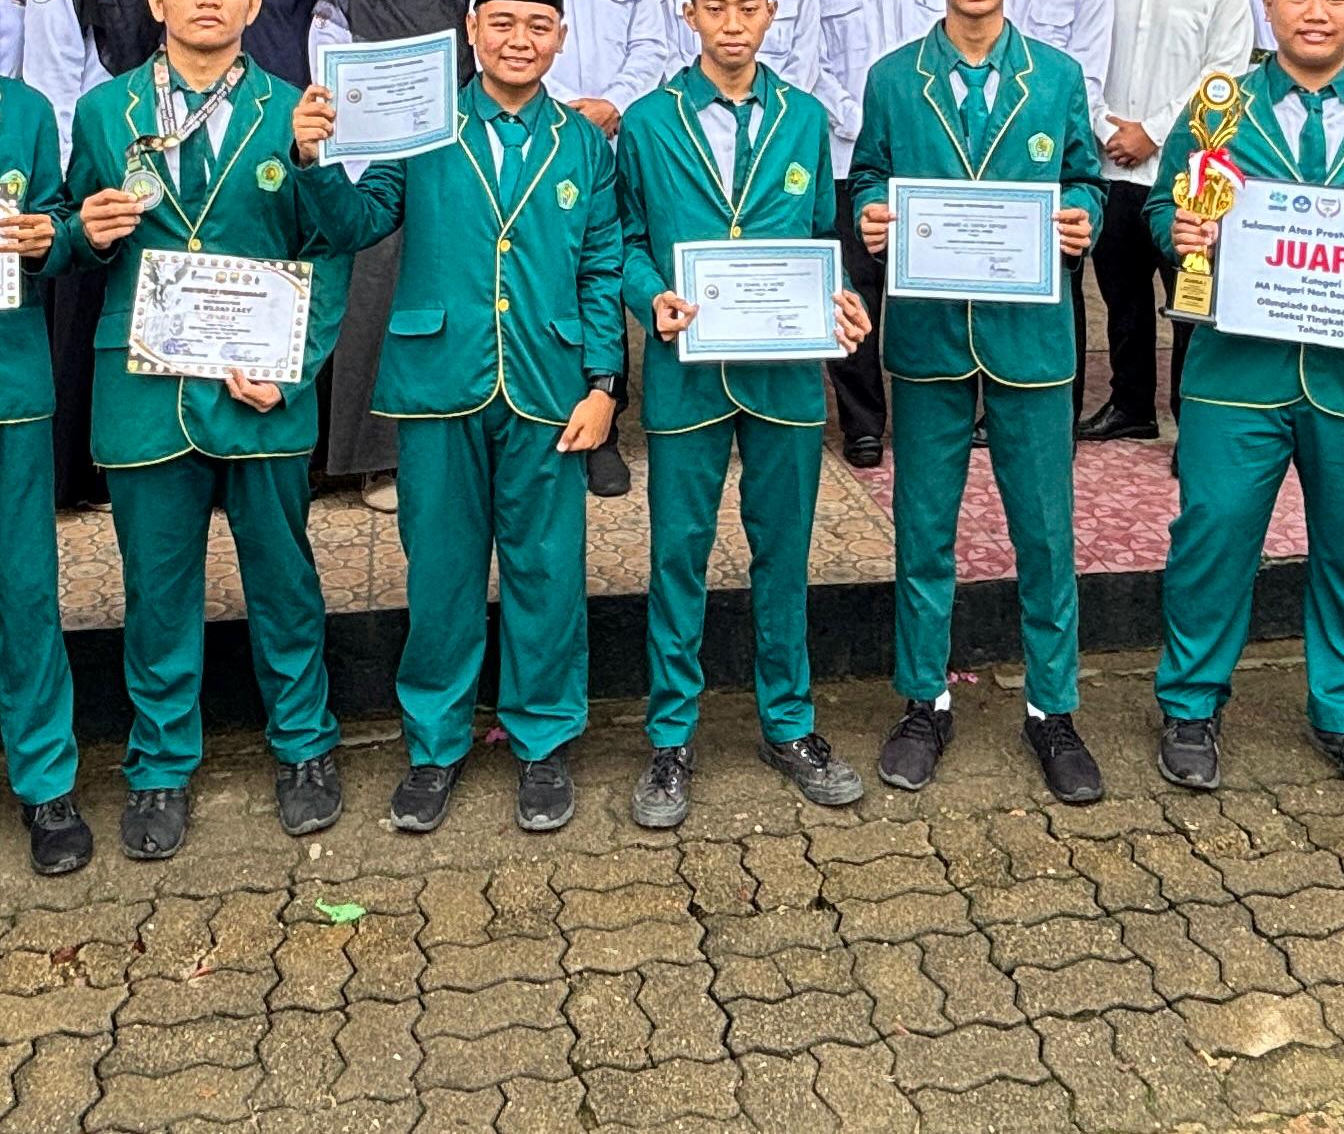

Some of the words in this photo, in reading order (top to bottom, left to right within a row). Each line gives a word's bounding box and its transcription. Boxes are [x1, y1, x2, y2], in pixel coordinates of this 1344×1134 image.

[1242, 219, 1286, 233] Selamat
[1288, 225, 1313, 237] Atas
[1255, 281, 1270, 291] MA
[1273, 283, 1305, 296] Negeri
[1307, 287, 1327, 298] Non
[1301, 276, 1343, 289] Kategori
[1256, 297, 1309, 312] Olimpiade
[1268, 309, 1304, 322] Seleksi
[1307, 314, 1344, 327] Tingkat
[1297, 324, 1328, 336] Tahun
